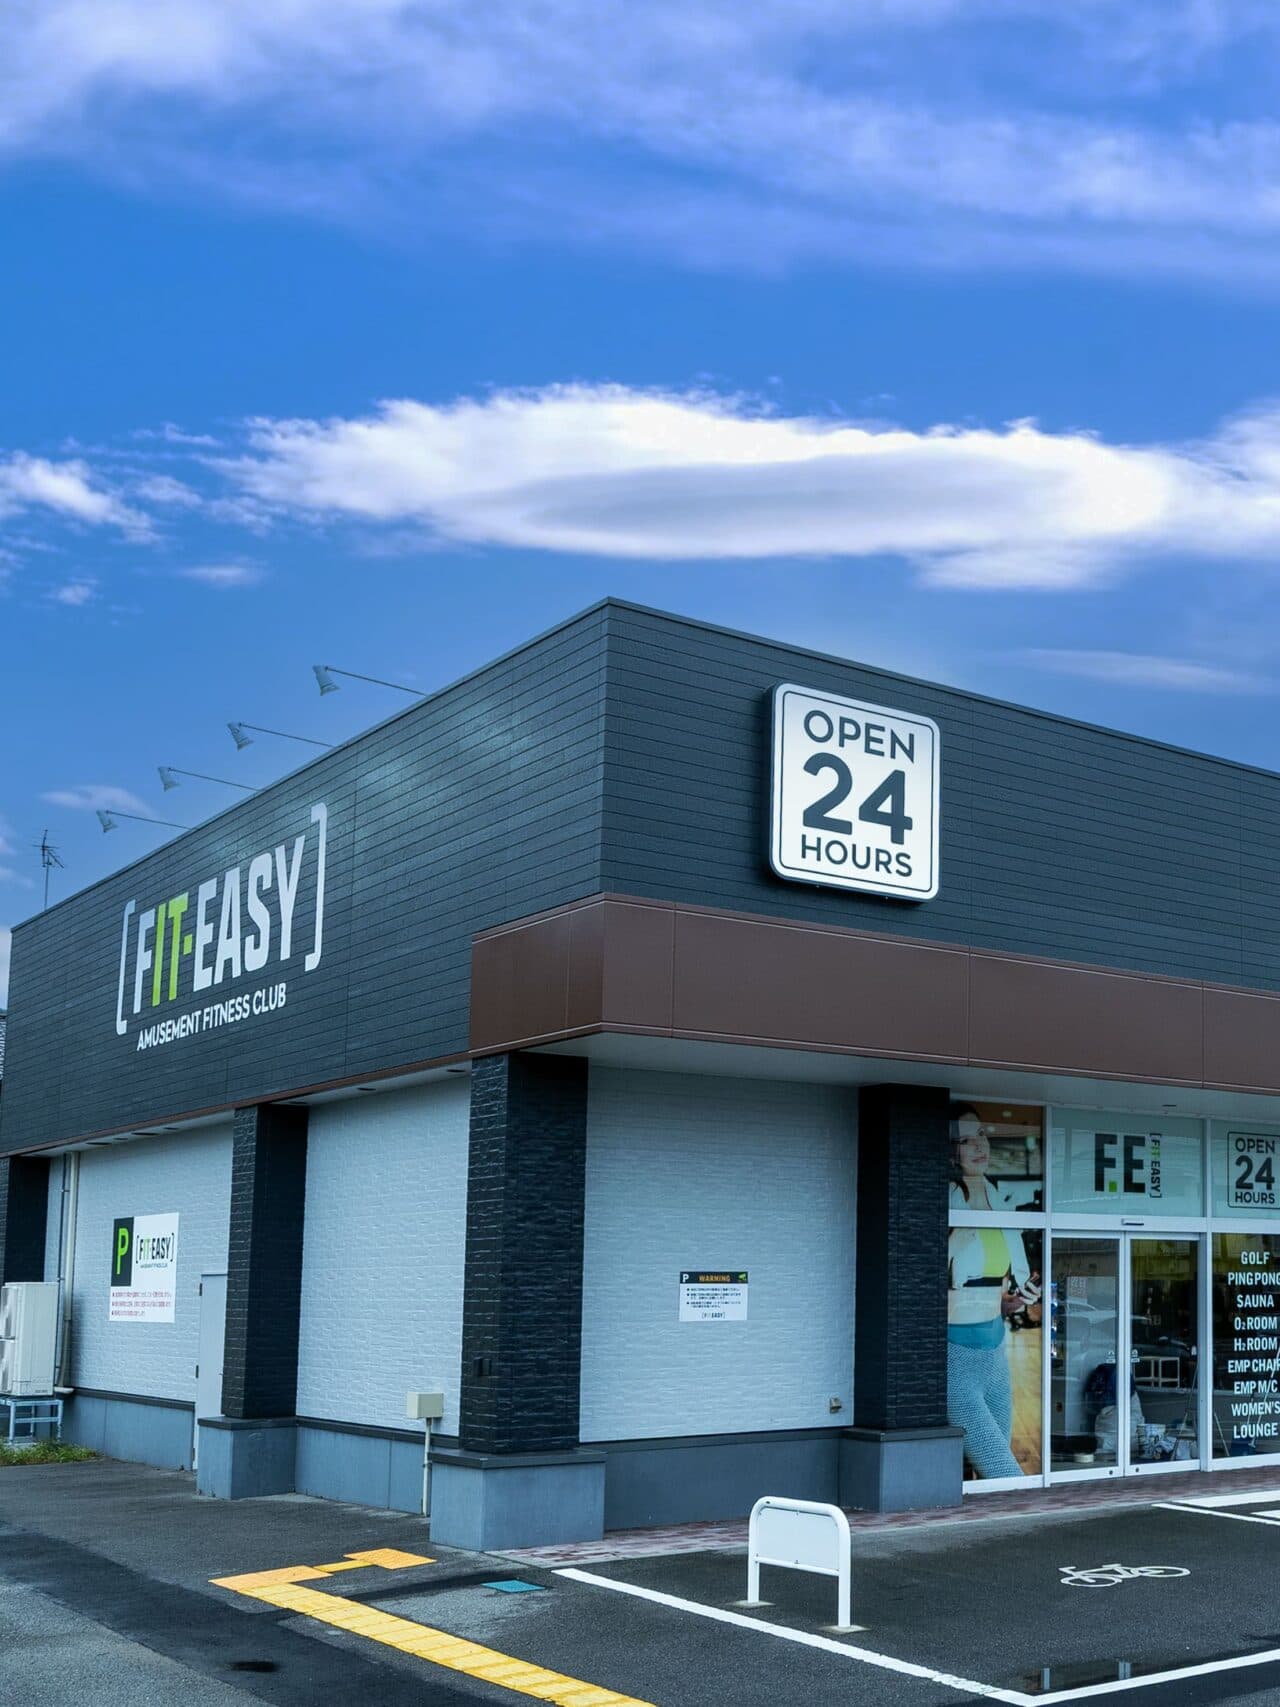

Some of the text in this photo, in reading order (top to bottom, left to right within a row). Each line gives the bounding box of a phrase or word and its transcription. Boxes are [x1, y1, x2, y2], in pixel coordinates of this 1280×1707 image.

[804, 710, 914, 764] OPEN
[803, 752, 912, 845] 24
[801, 834, 912, 877] HOURS
[137, 982, 287, 1051] AMUSEMENT FITNESS CLUB
[1235, 1137, 1275, 1154] OPEN
[1235, 1155, 1275, 1190] 24
[1235, 1191, 1275, 1204] HOURS
[117, 1228, 129, 1274] P
[1241, 1251, 1270, 1265] GOLF
[682, 1273, 689, 1283] P
[1237, 1294, 1274, 1308] SAUNA
[1228, 1360, 1250, 1373] EMP
[1234, 1381, 1256, 1394] EMP
[1232, 1401, 1280, 1417] WOMEN'S
[1234, 1423, 1278, 1439] LOUNGE
